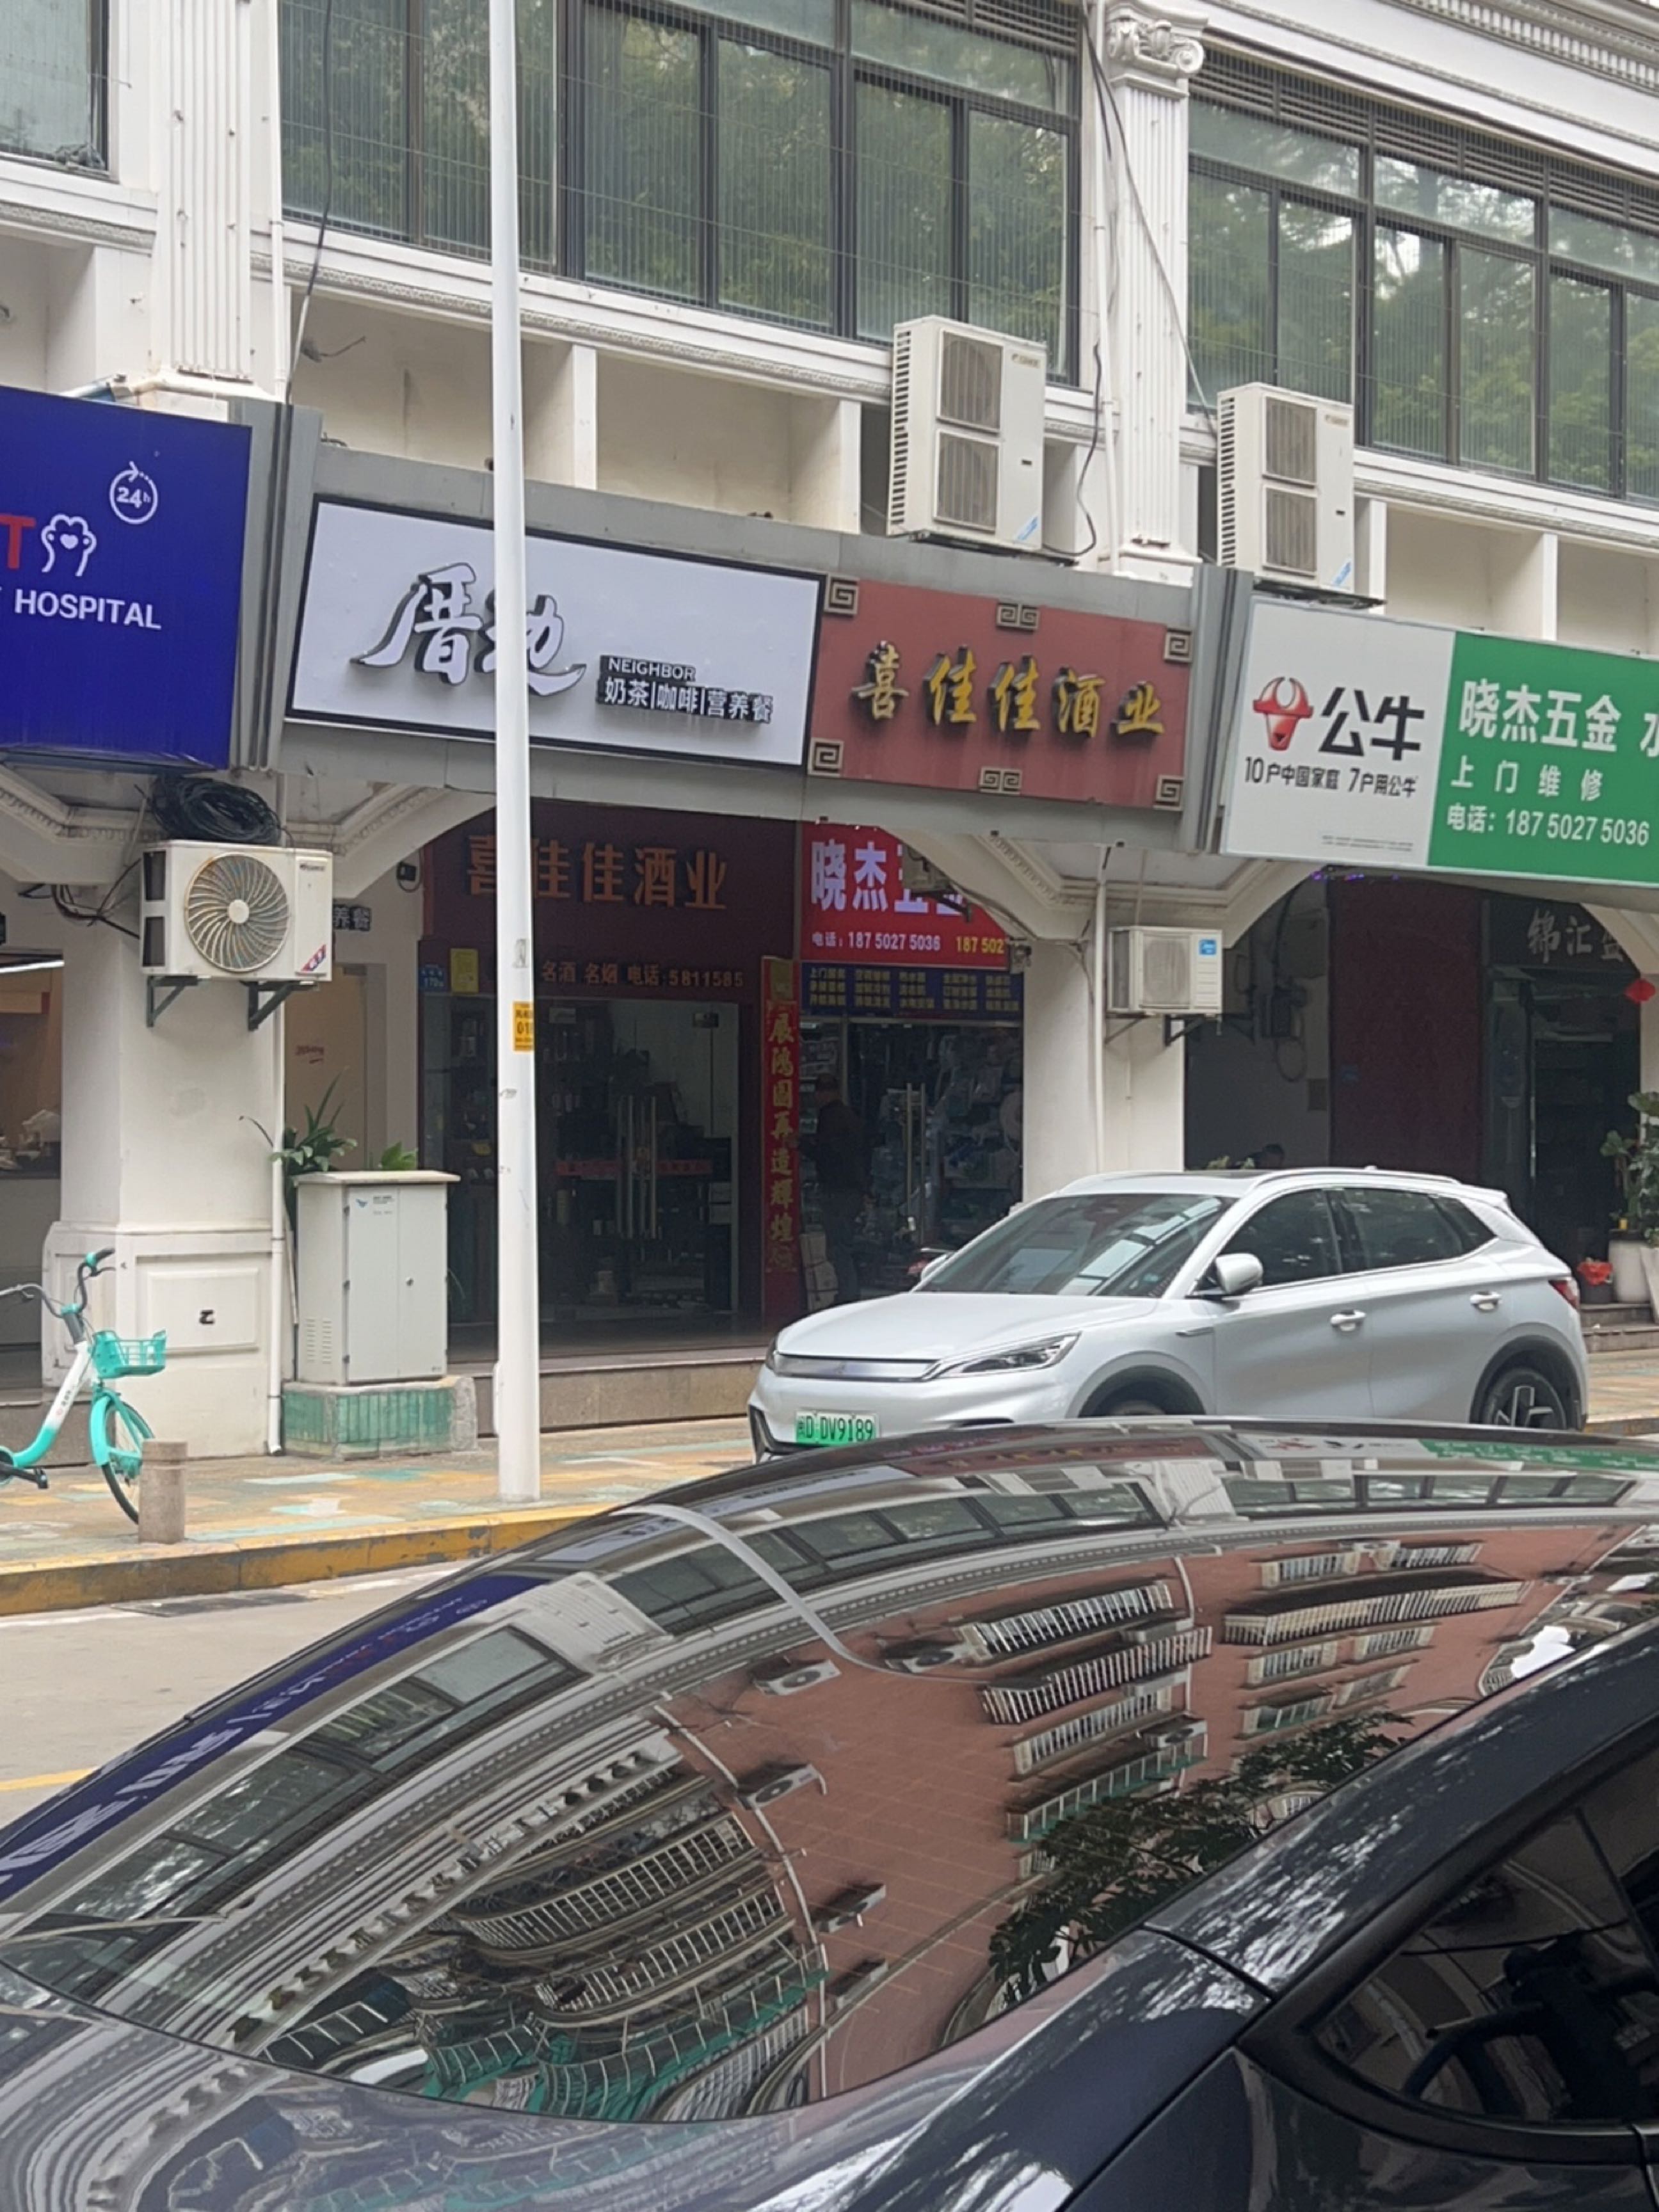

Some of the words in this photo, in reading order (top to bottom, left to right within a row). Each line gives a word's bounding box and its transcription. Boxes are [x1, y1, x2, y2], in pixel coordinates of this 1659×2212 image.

[14, 588, 162, 631] HOSPITAL
[607, 657, 696, 681] NEIGHBOR
[853, 640, 1164, 738] 喜佳佳酒业
[1318, 686, 1425, 761] 公牛
[1458, 678, 1621, 753] 晓杰五金
[1244, 757, 1341, 790] 10户中国家庭
[1450, 755, 1603, 803] 上门维修
[1505, 809, 1544, 837] 187
[811, 838, 964, 915] 晓杰
[848, 931, 872, 949] 187
[875, 933, 906, 950] 5027
